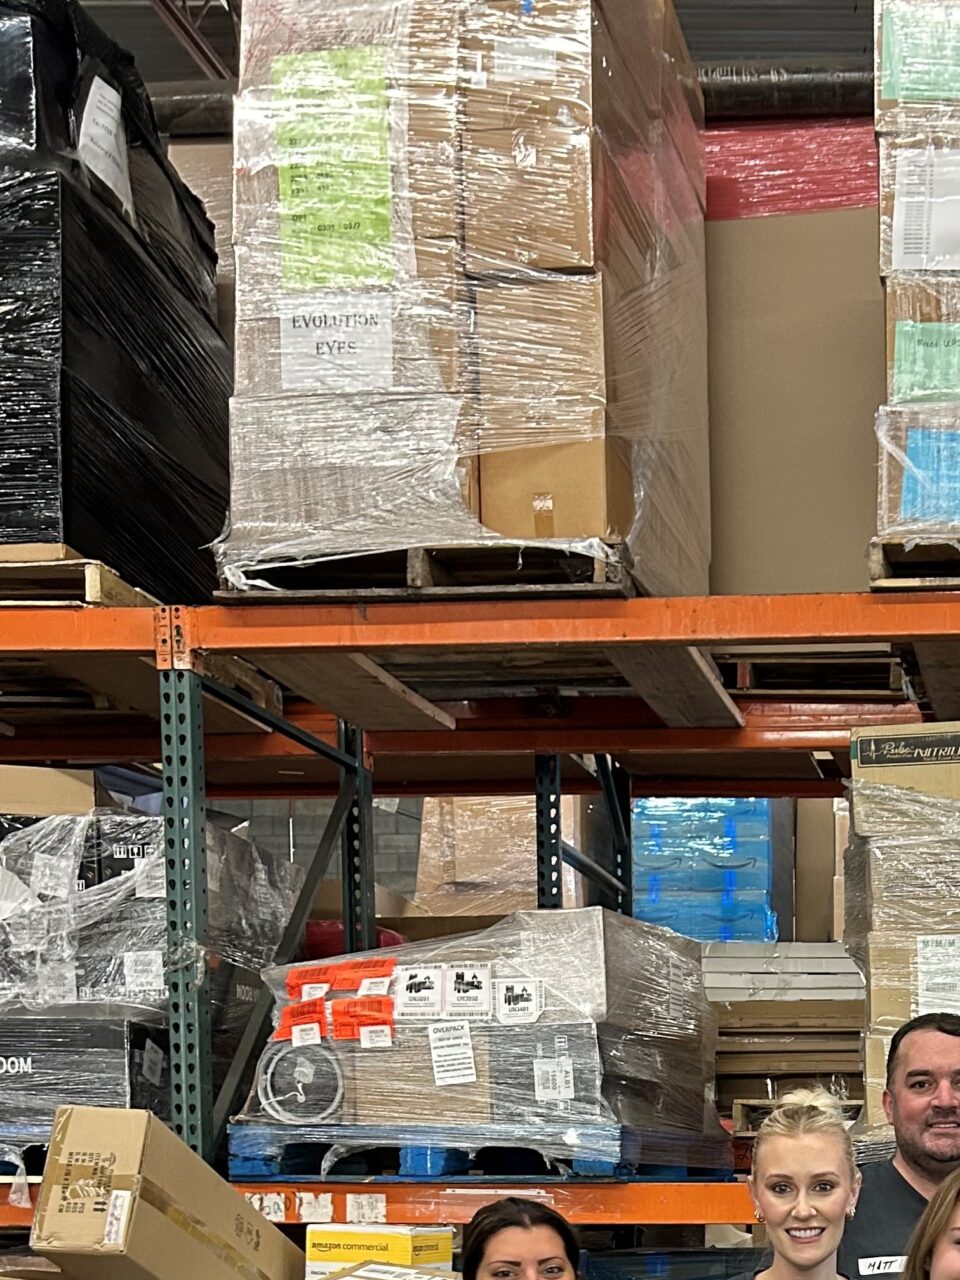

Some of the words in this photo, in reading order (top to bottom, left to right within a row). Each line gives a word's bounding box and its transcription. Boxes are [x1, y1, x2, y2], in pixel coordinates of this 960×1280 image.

[292, 313, 380, 329] EVOLUTION
[316, 340, 358, 355] EYES
[311, 1241, 341, 1252] amazon
[342, 1242, 389, 1251] commercial
